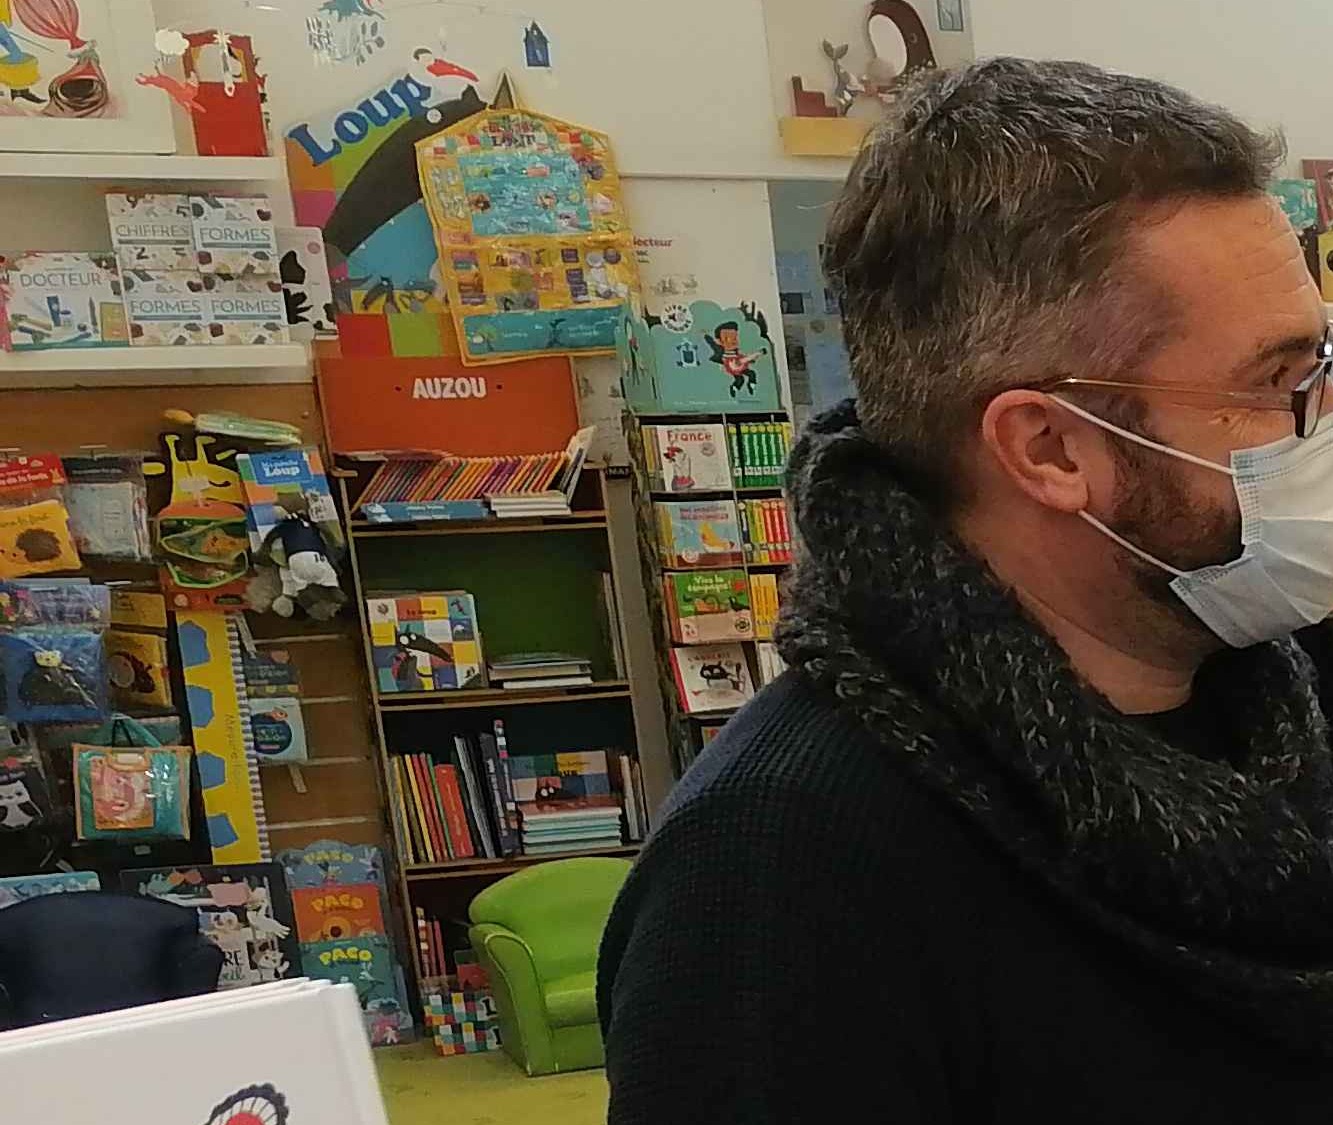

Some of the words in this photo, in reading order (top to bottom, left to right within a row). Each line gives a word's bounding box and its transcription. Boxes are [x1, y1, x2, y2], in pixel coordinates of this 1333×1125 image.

[289, 72, 432, 166] Loup
[116, 224, 190, 238] CHIFFRES
[200, 227, 271, 242] FORMES
[20, 273, 101, 288] DOCTEUR
[131, 301, 200, 314] FORMES
[212, 300, 281, 314] FORMES
[412, 377, 487, 399] AUZOU
[667, 430, 712, 442] France
[311, 893, 364, 912] PACO
[319, 946, 373, 967] PACO
